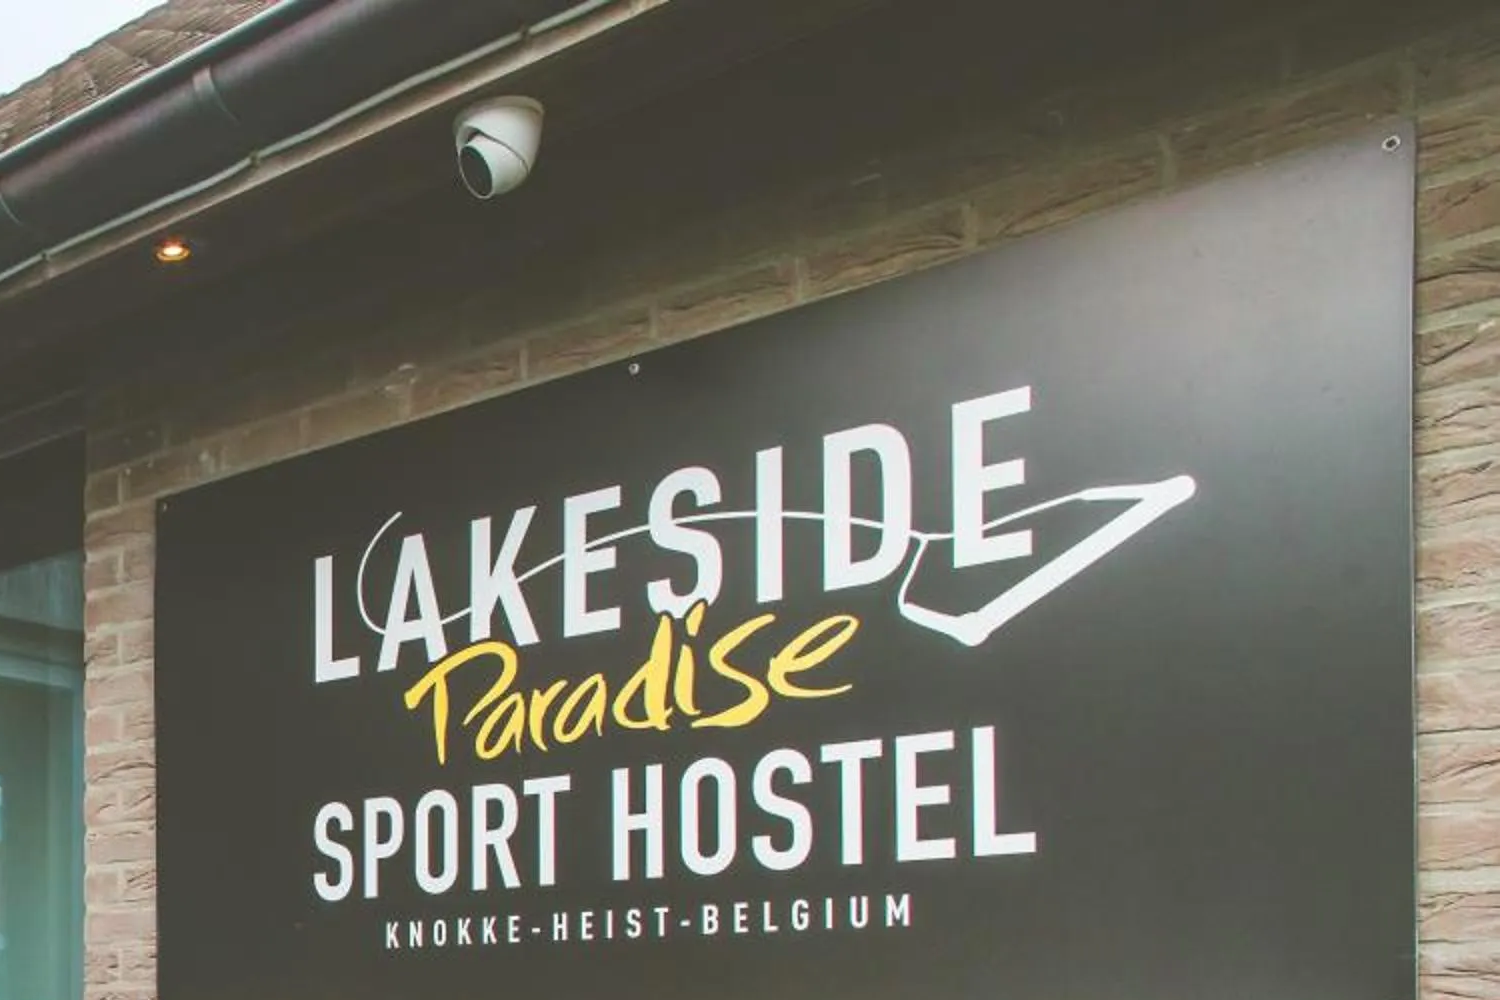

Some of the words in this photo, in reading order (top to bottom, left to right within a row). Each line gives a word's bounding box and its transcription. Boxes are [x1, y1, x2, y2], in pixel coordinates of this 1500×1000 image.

[313, 385, 1033, 683] LAKESIDE
[404, 601, 859, 765] Paradise
[312, 775, 572, 902] SPORT
[612, 725, 1037, 882] HOSTEL
[385, 893, 913, 951] KNOKKE-HEIST-BELGIUM
